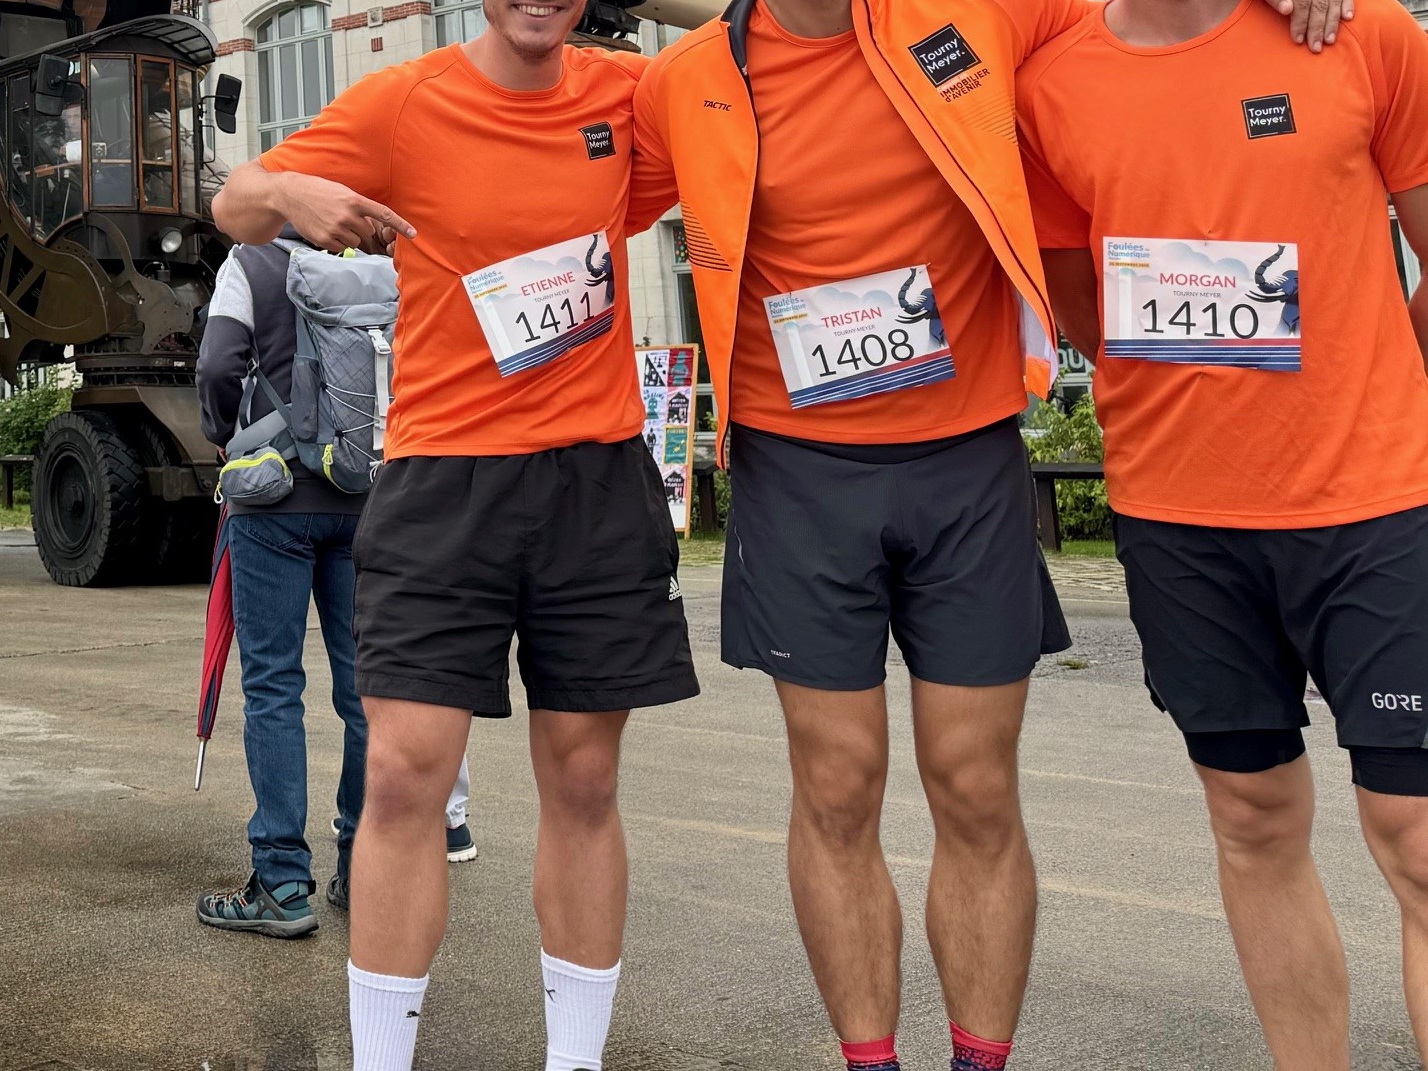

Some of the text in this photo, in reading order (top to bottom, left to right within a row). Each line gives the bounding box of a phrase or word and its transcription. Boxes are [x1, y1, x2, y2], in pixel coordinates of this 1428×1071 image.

[919, 38, 958, 64] Tourny
[926, 49, 966, 74] Meyer.
[939, 68, 991, 98] IMMOBILIER
[945, 80, 982, 103] d'AVENIR
[703, 100, 732, 111] TACTIC
[1248, 105, 1286, 118] Tourny
[1249, 116, 1287, 127] Meyer.
[586, 131, 610, 141] Tourny
[521, 271, 576, 297] ETIENNE
[1159, 272, 1237, 289] MORGAN
[534, 288, 571, 303] TOURNY MEYER
[515, 291, 595, 343] 1411
[821, 306, 883, 329] TRISTAN
[1142, 299, 1259, 340] 1410
[833, 324, 876, 337] TOURNY MEYER
[811, 328, 915, 378] 1408
[1371, 692, 1423, 711] GORE
